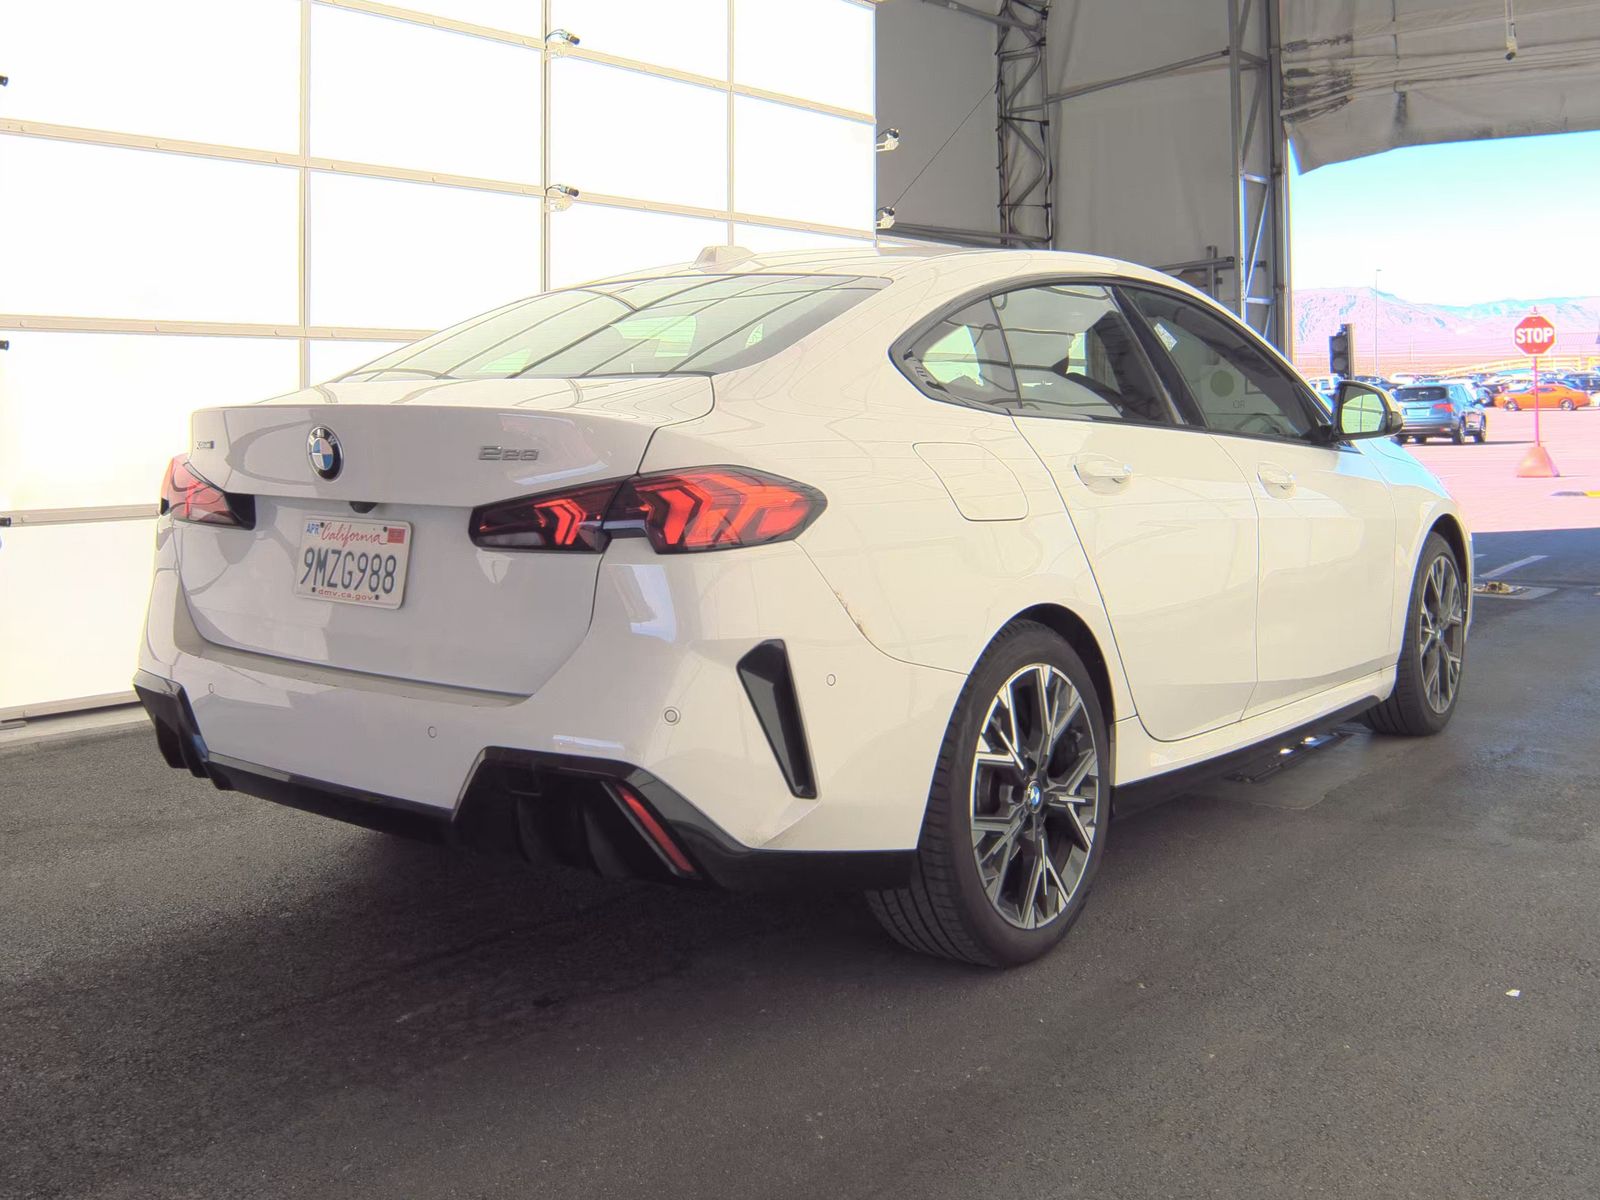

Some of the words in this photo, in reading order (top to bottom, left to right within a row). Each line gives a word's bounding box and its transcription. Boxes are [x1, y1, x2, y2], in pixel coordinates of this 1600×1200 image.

[1516, 327, 1553, 344] STOP
[478, 445, 539, 461] 228
[321, 522, 387, 547] California
[300, 547, 396, 594] 9MZG988
[318, 588, 373, 601] dmv.ca.gov
